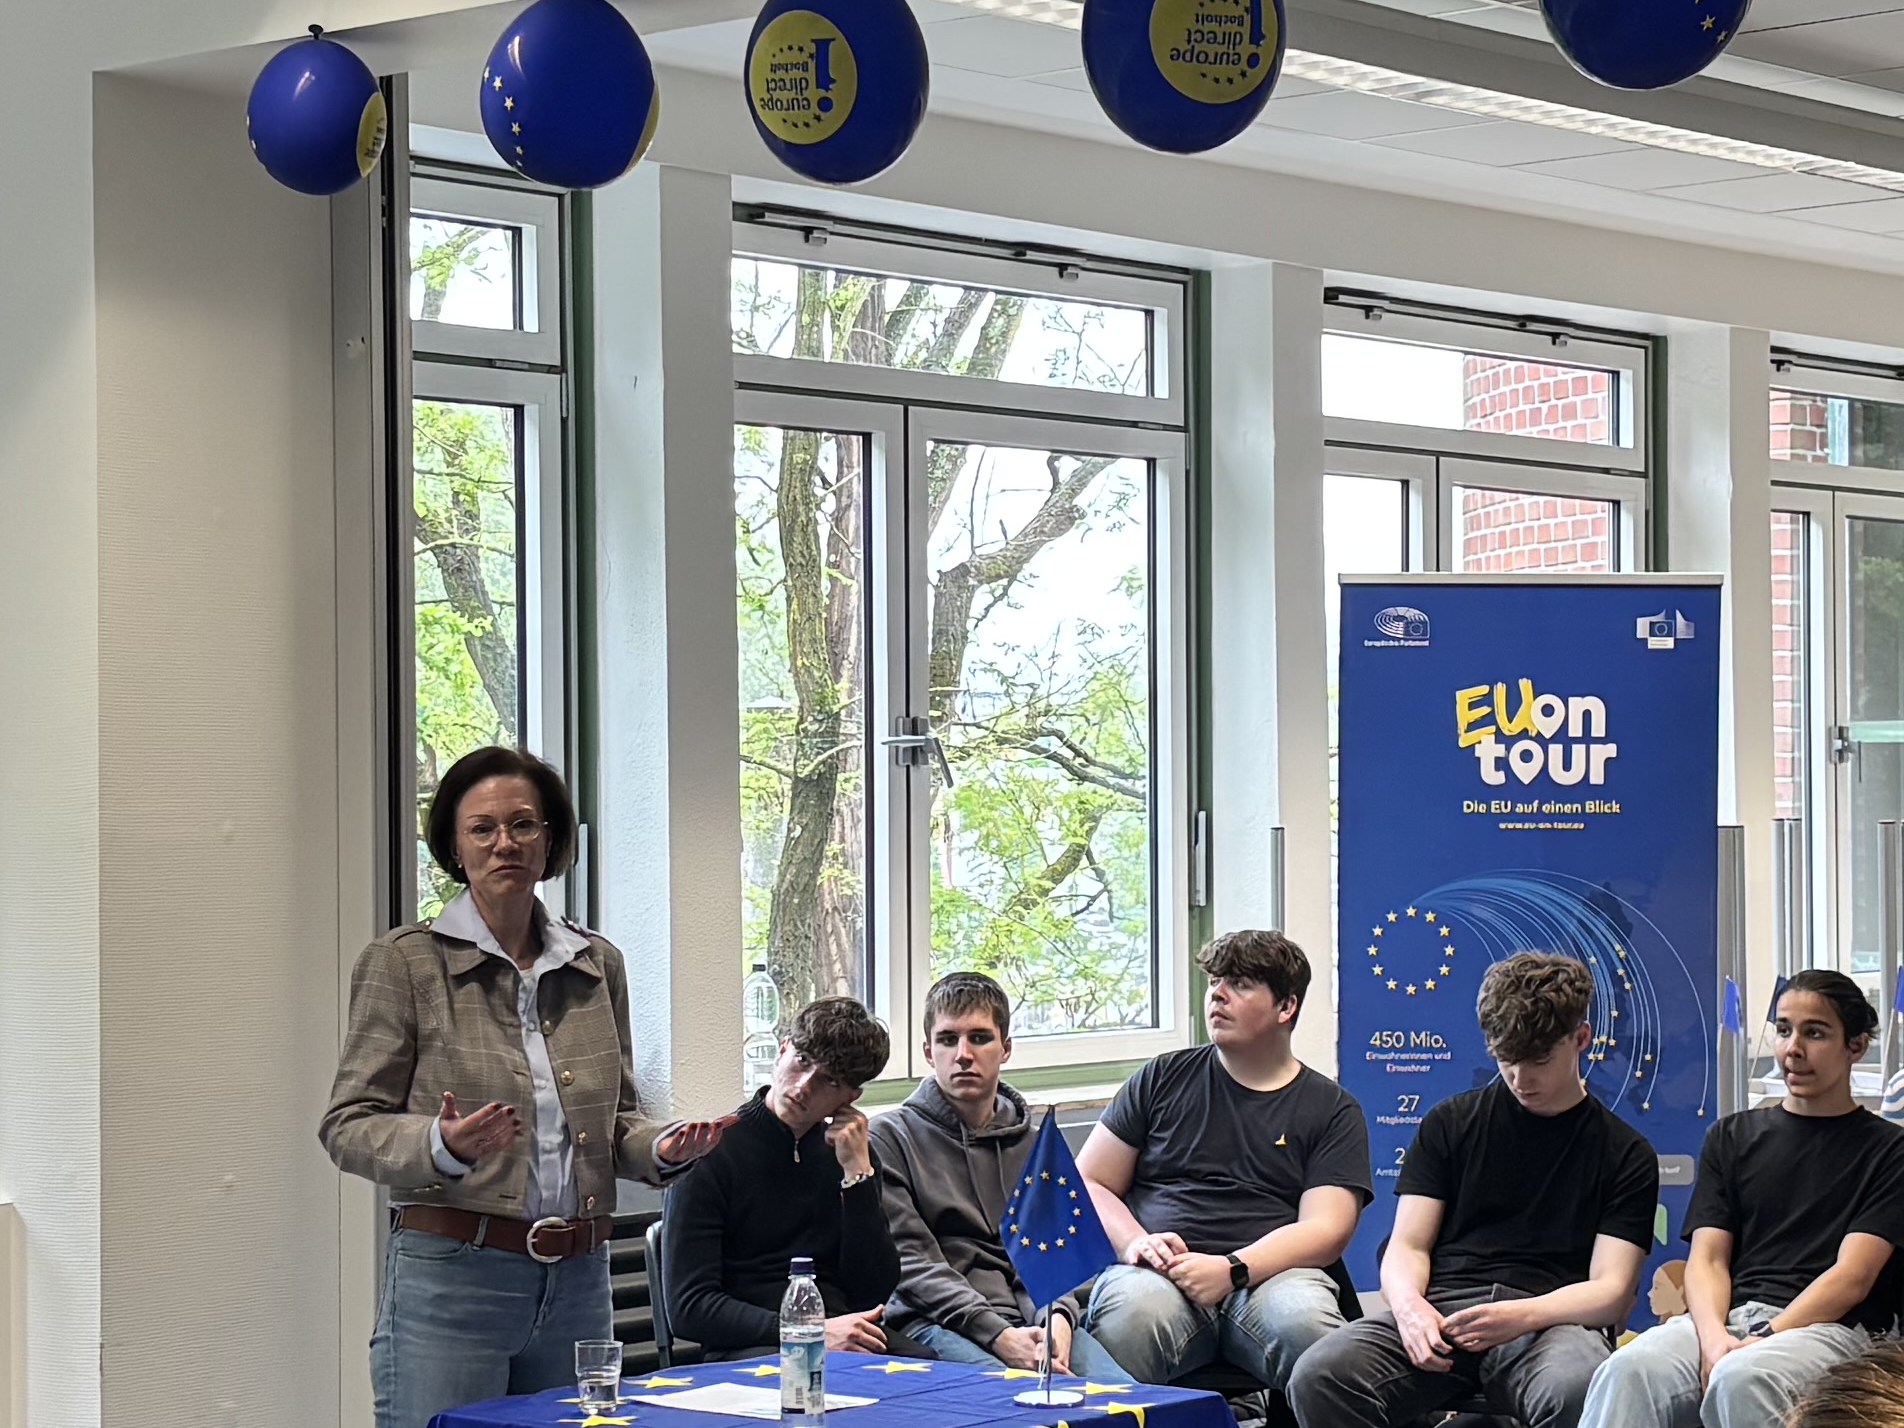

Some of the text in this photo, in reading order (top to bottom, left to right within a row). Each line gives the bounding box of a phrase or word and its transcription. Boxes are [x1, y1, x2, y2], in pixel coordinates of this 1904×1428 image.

[1194, 12, 1245, 28] Bocholt
[1186, 28, 1244, 51] direct
[1169, 44, 1242, 65] europe
[766, 77, 809, 97] direct
[759, 93, 811, 111] europe
[1455, 677, 1606, 748] EU on
[1474, 734, 1618, 786] tour
[1462, 799, 1621, 814] Die EU auf einen Blick
[1369, 1030, 1447, 1049] 450 Mio.
[1396, 1094, 1421, 1112] 27
